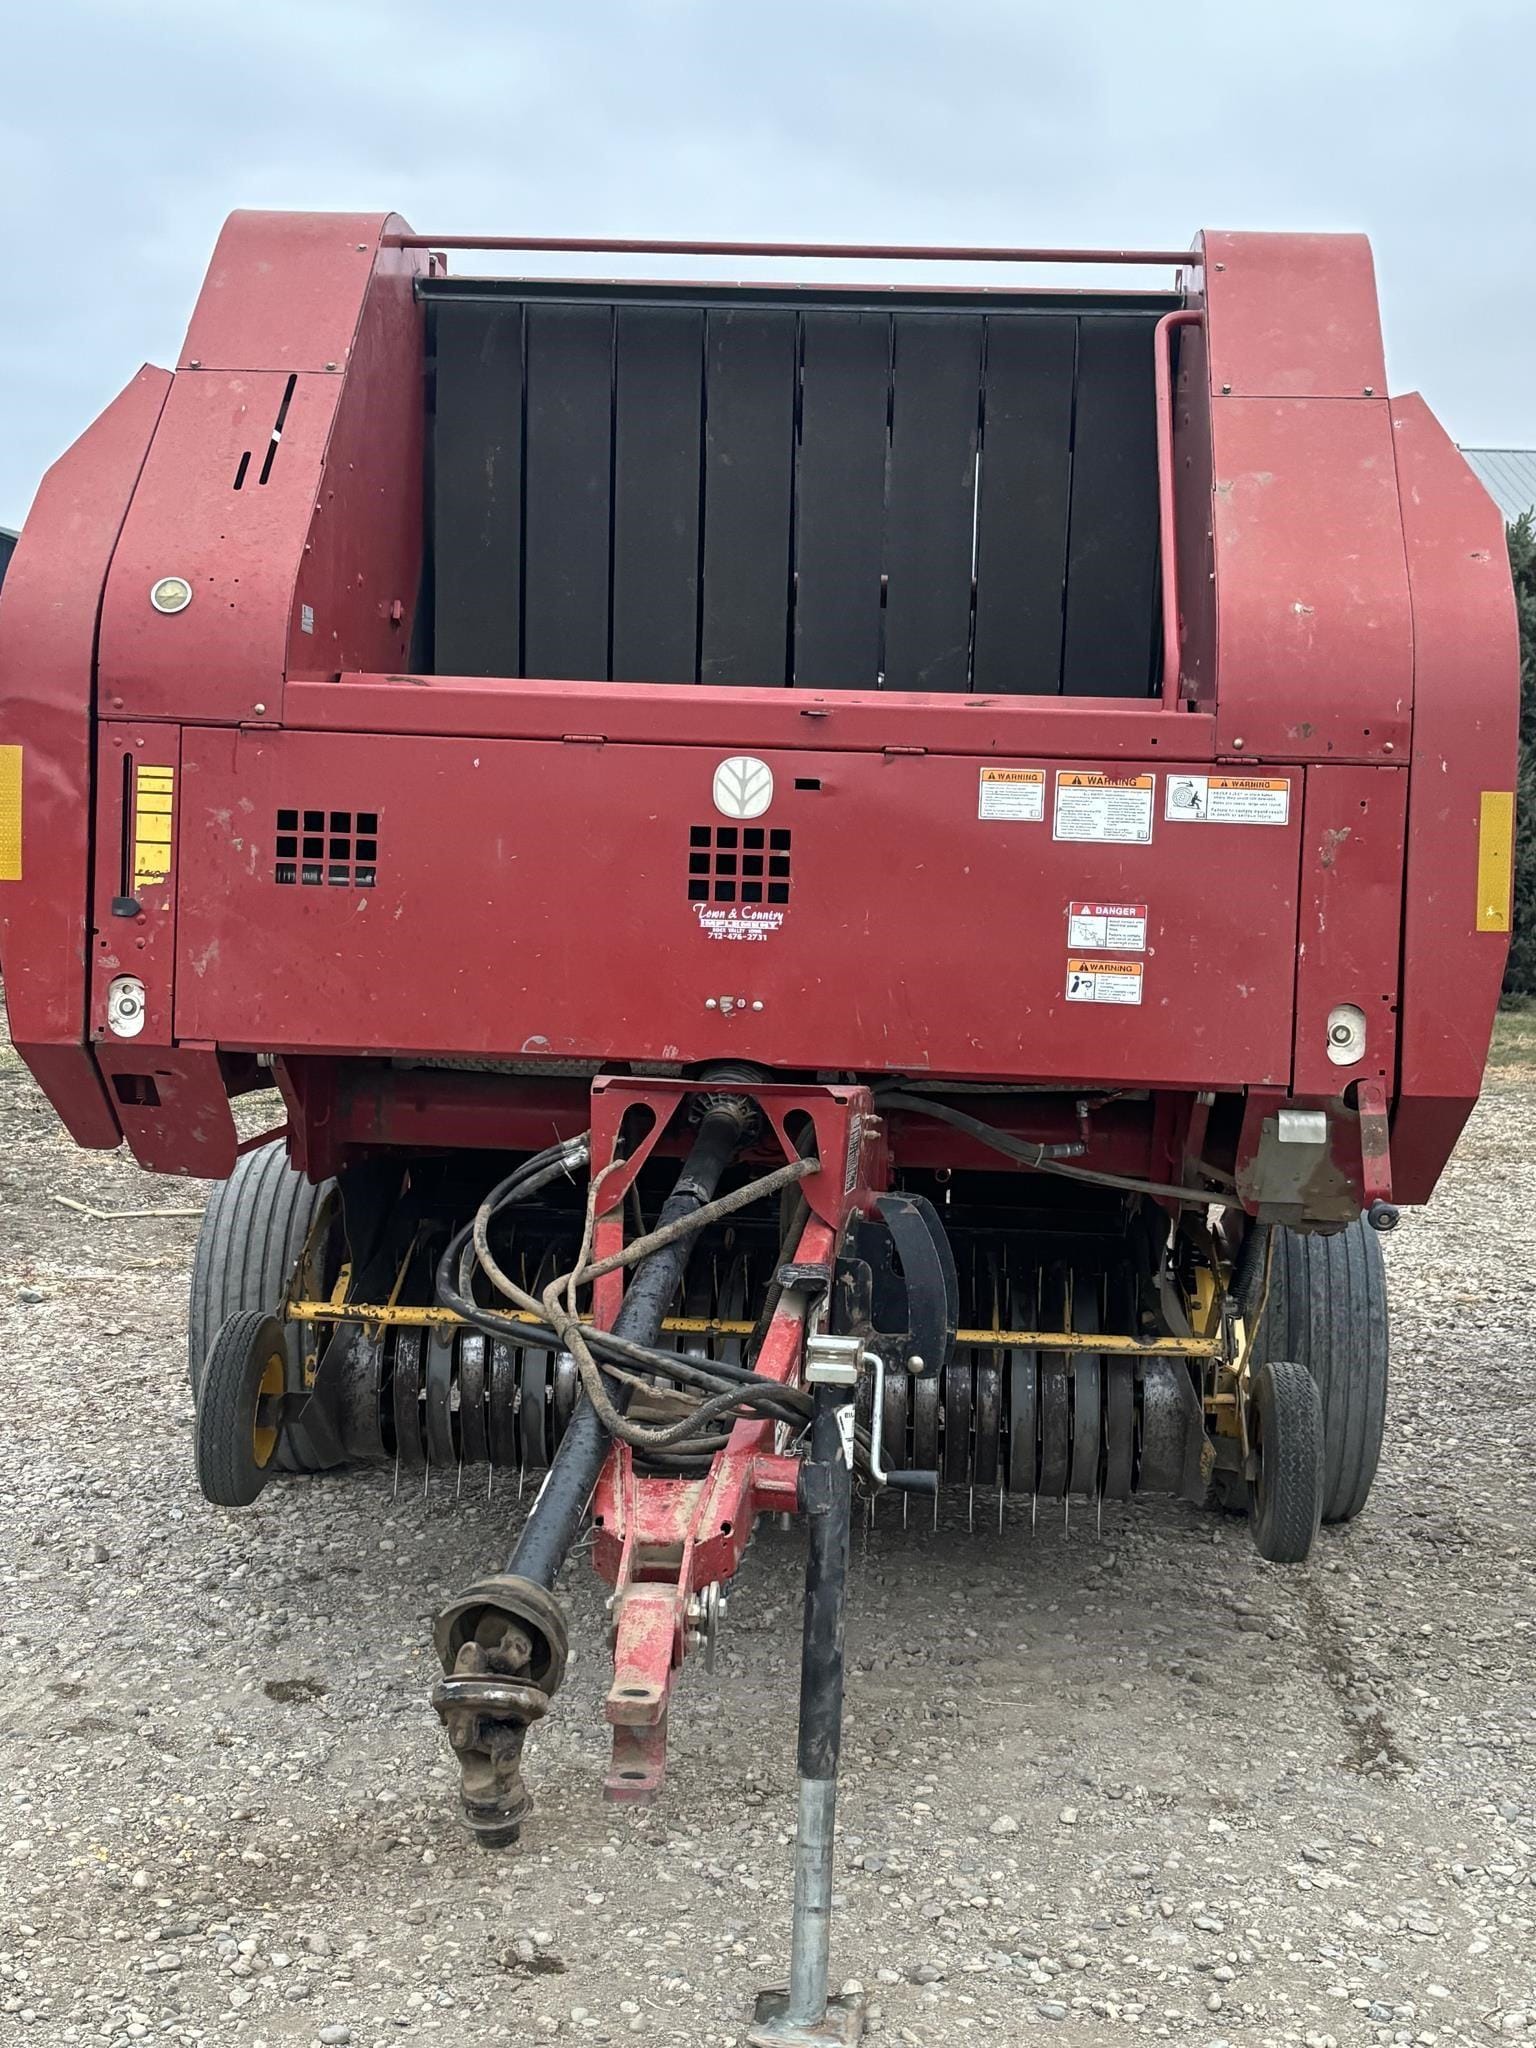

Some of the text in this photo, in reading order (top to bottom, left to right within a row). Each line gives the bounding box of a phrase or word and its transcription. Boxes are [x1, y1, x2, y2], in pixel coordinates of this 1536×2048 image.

[998, 772, 1038, 781] WARNING
[1087, 776, 1137, 786] WARNING
[692, 903, 784, 925] Town & Country
[1095, 907, 1136, 915] DANGER
[700, 919, 779, 929] IMPLEMENT
[708, 932, 767, 941] 712-476-2731
[1090, 963, 1133, 972] WARNING
